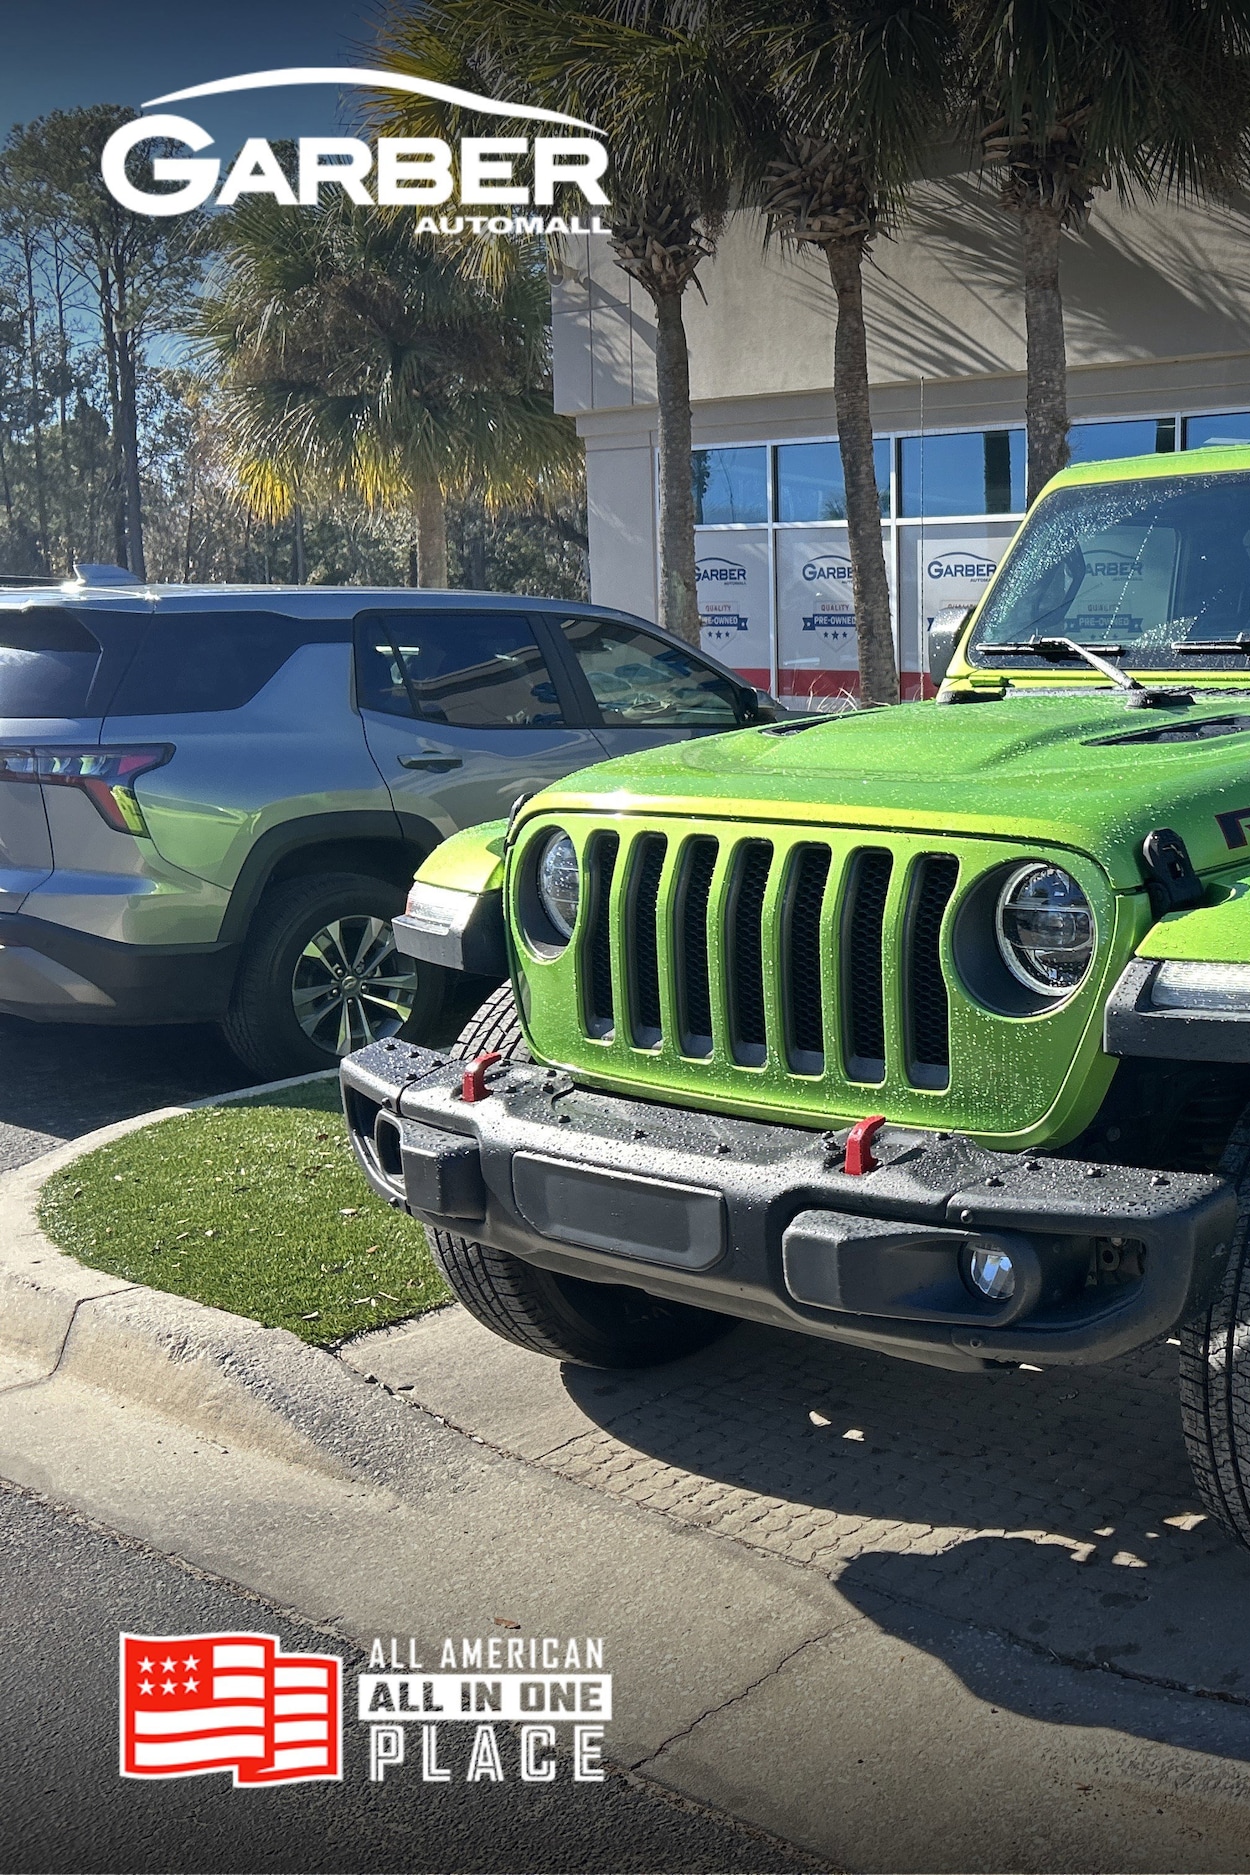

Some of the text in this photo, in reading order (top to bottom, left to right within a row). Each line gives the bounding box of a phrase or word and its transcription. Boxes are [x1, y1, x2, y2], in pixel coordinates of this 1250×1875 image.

[802, 563, 853, 581] GARBE
[927, 560, 997, 580] GARBER
[1086, 562, 1143, 577] ARBER
[705, 604, 732, 612] QUALITY
[820, 604, 850, 612] QUALITY
